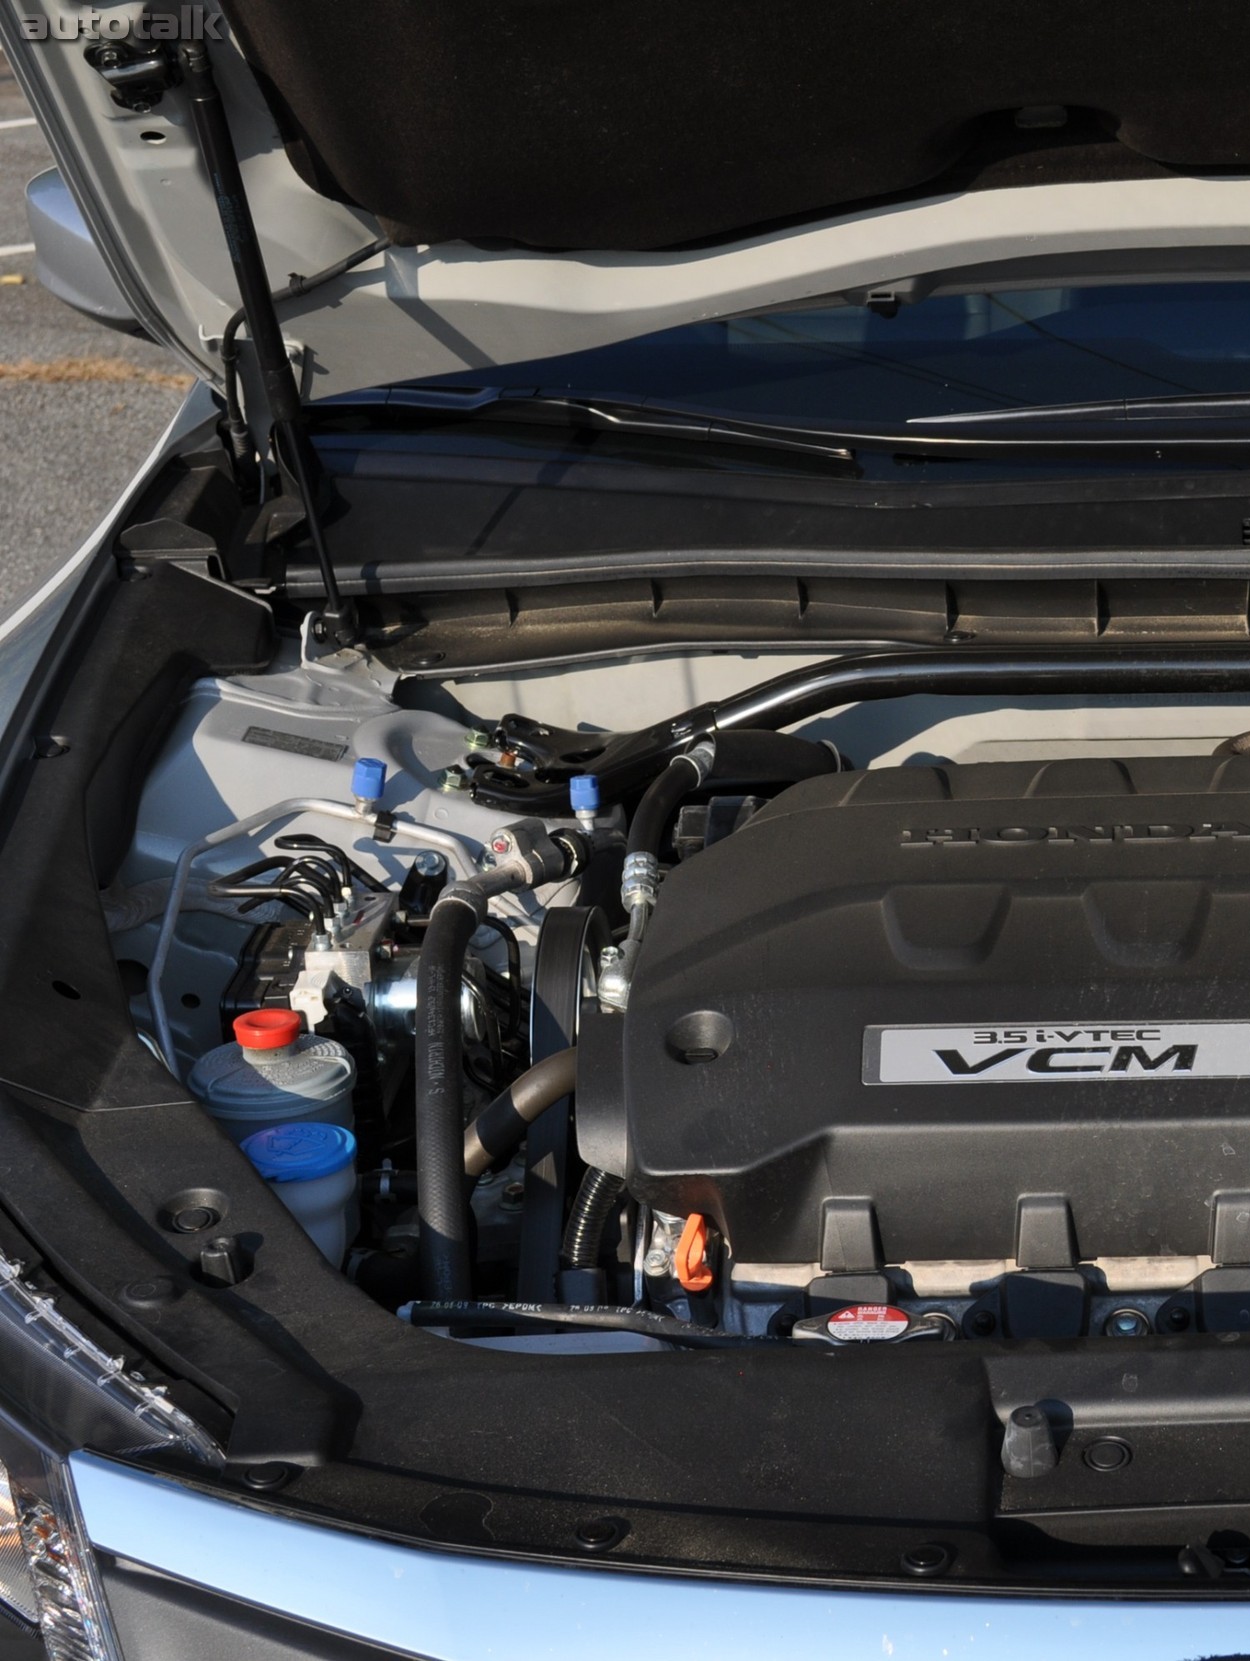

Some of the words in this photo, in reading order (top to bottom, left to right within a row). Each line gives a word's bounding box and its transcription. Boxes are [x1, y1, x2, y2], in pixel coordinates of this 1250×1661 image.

[973, 1030, 1028, 1045] 3.5
[1036, 1028, 1161, 1043] i-VTEC
[932, 1044, 1200, 1076] VCM
